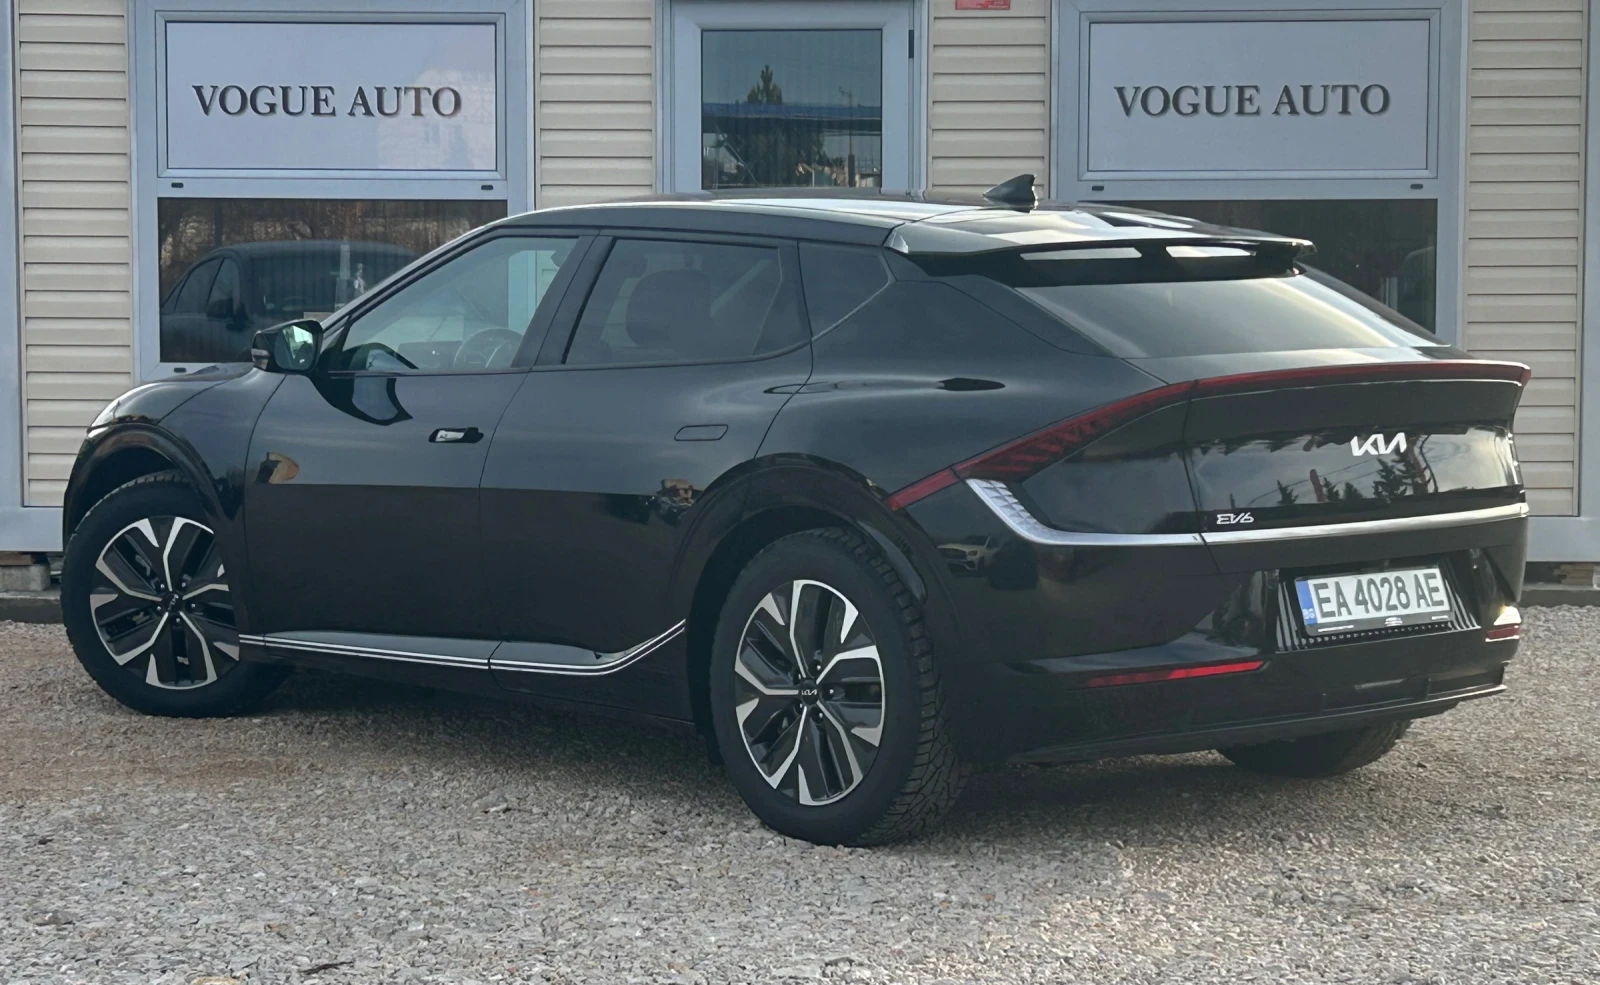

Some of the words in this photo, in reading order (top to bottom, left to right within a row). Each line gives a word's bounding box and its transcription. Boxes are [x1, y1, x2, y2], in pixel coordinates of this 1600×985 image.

[192, 84, 337, 117] VOGUE
[347, 85, 463, 117] AUTO
[1113, 84, 1260, 117] VOGUE
[1271, 83, 1391, 116] AUTO
[1350, 432, 1407, 456] KIA
[1216, 512, 1254, 525] EV6
[1312, 582, 1353, 619] EA
[1354, 575, 1411, 614] 4028
[1413, 572, 1445, 609] AE
